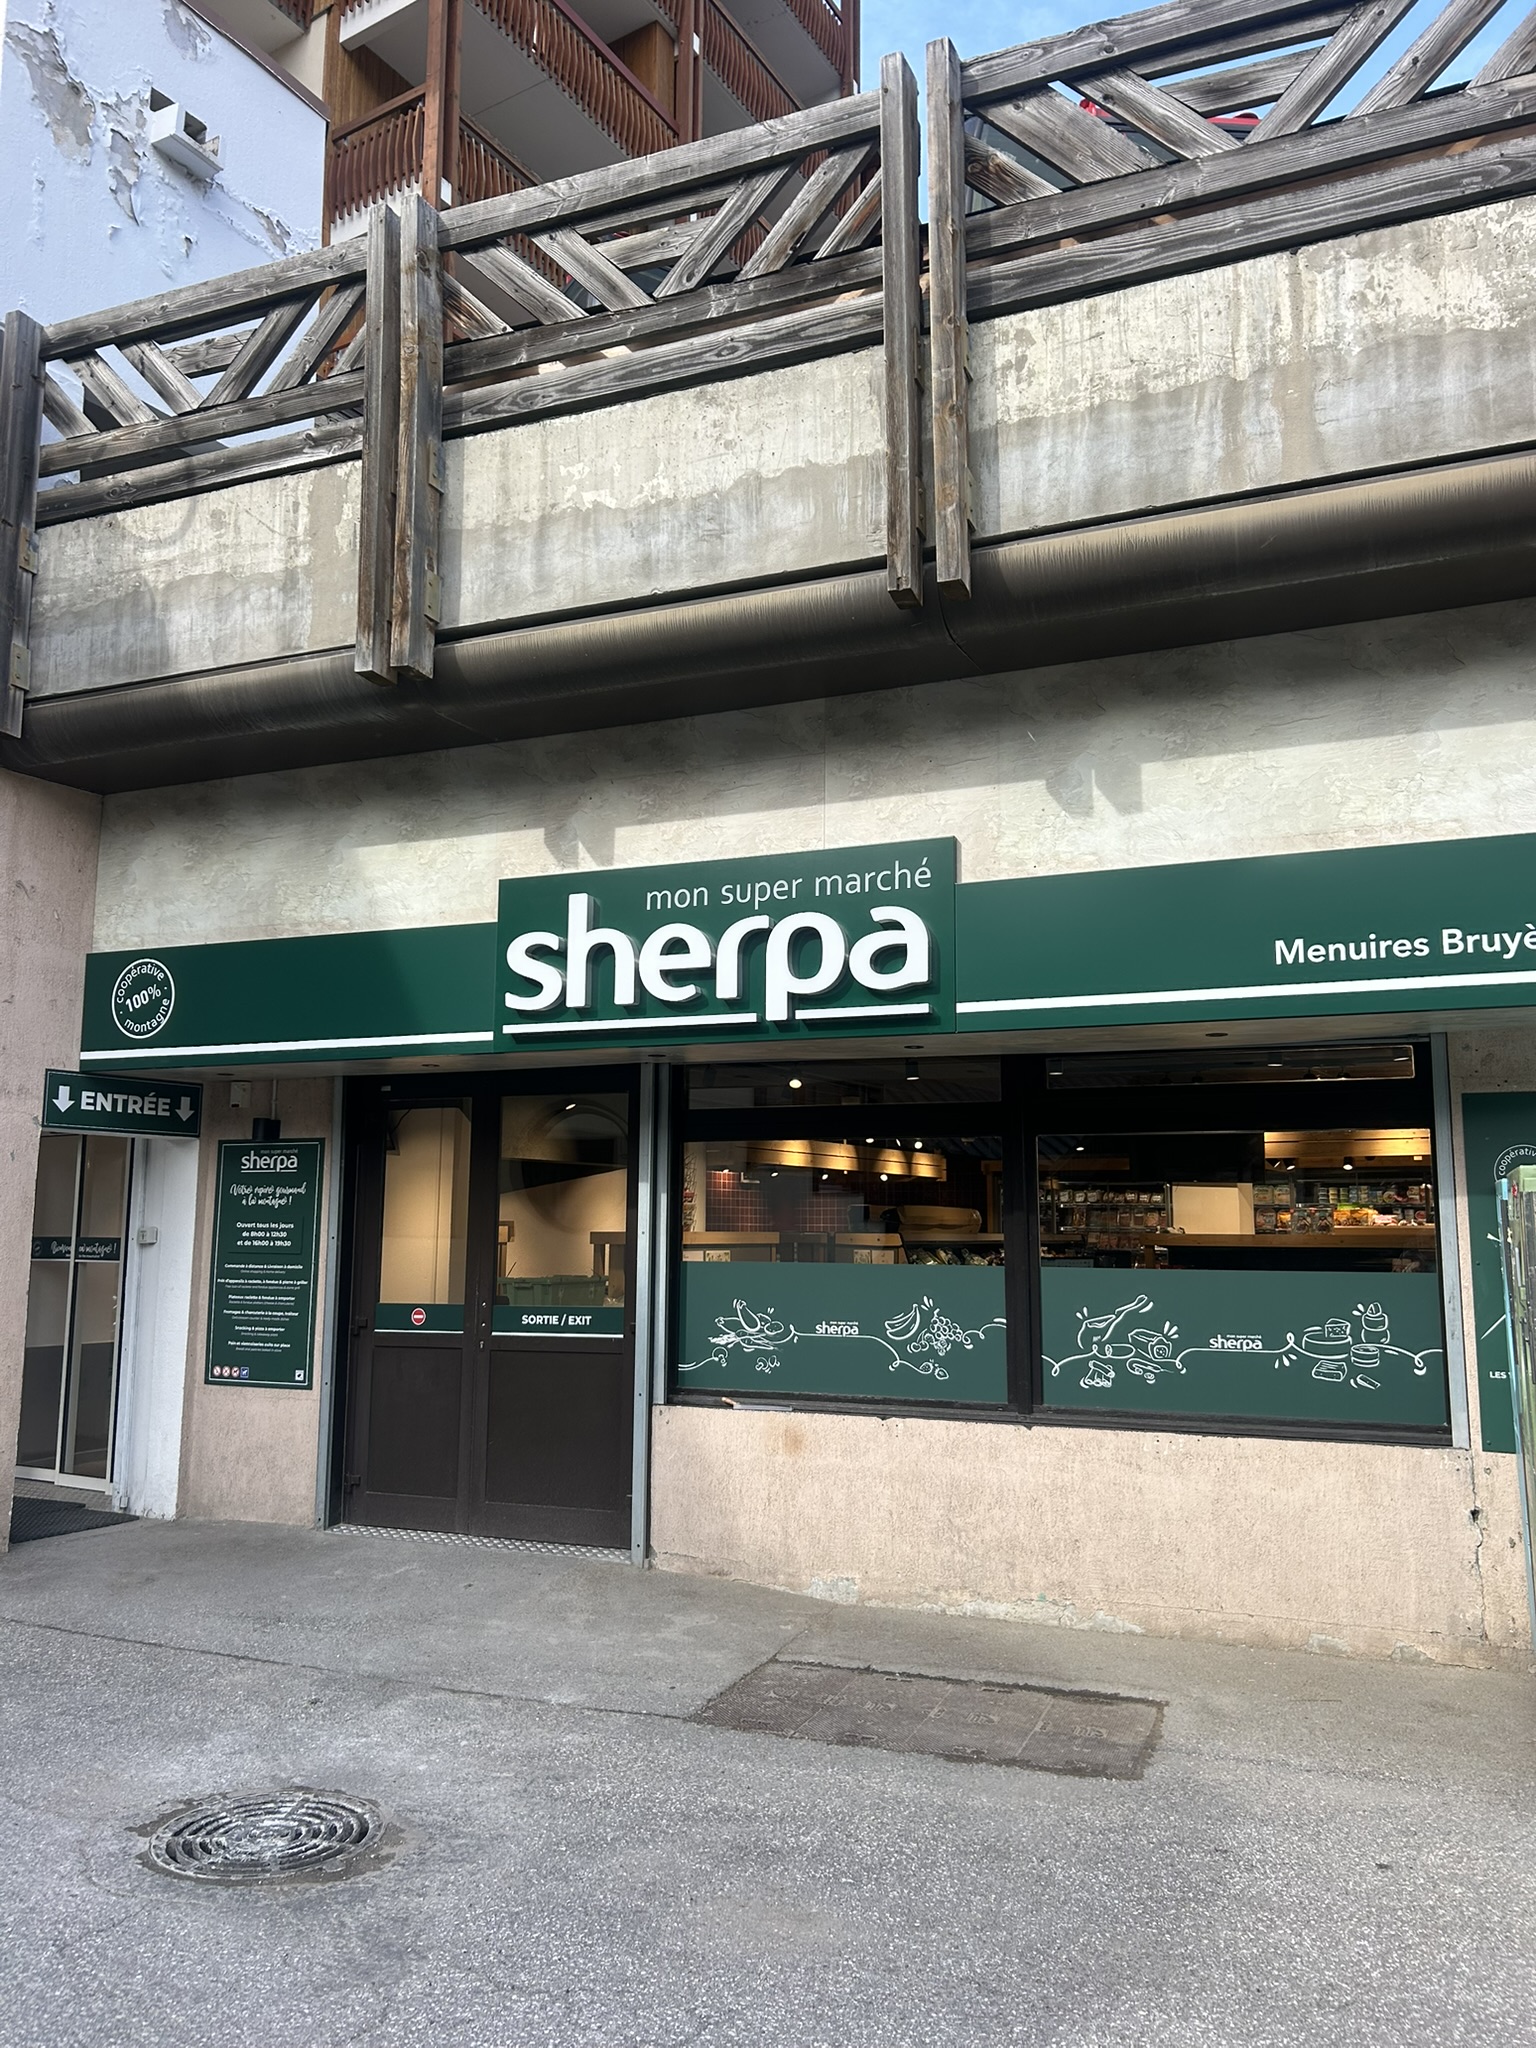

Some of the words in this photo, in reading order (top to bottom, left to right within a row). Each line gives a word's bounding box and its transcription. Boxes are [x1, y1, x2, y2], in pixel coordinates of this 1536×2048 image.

[646, 887, 709, 911] mon
[720, 876, 803, 911] super
[814, 856, 932, 898] marché
[504, 892, 933, 1022] sherpa
[1274, 933, 1431, 966] Menuires
[116, 963, 165, 1004] coopérative
[125, 983, 162, 1013] 100%
[124, 998, 170, 1033] montagne
[80, 1090, 171, 1117] ENTRÉE
[240, 1150, 298, 1172] sherpa
[278, 1222, 295, 1230] jours
[521, 1314, 560, 1326] SORTIE
[560, 1313, 568, 1327] /
[568, 1315, 592, 1326] EXIT
[815, 1320, 859, 1337] sherpa
[1208, 1333, 1263, 1352] sherpa
